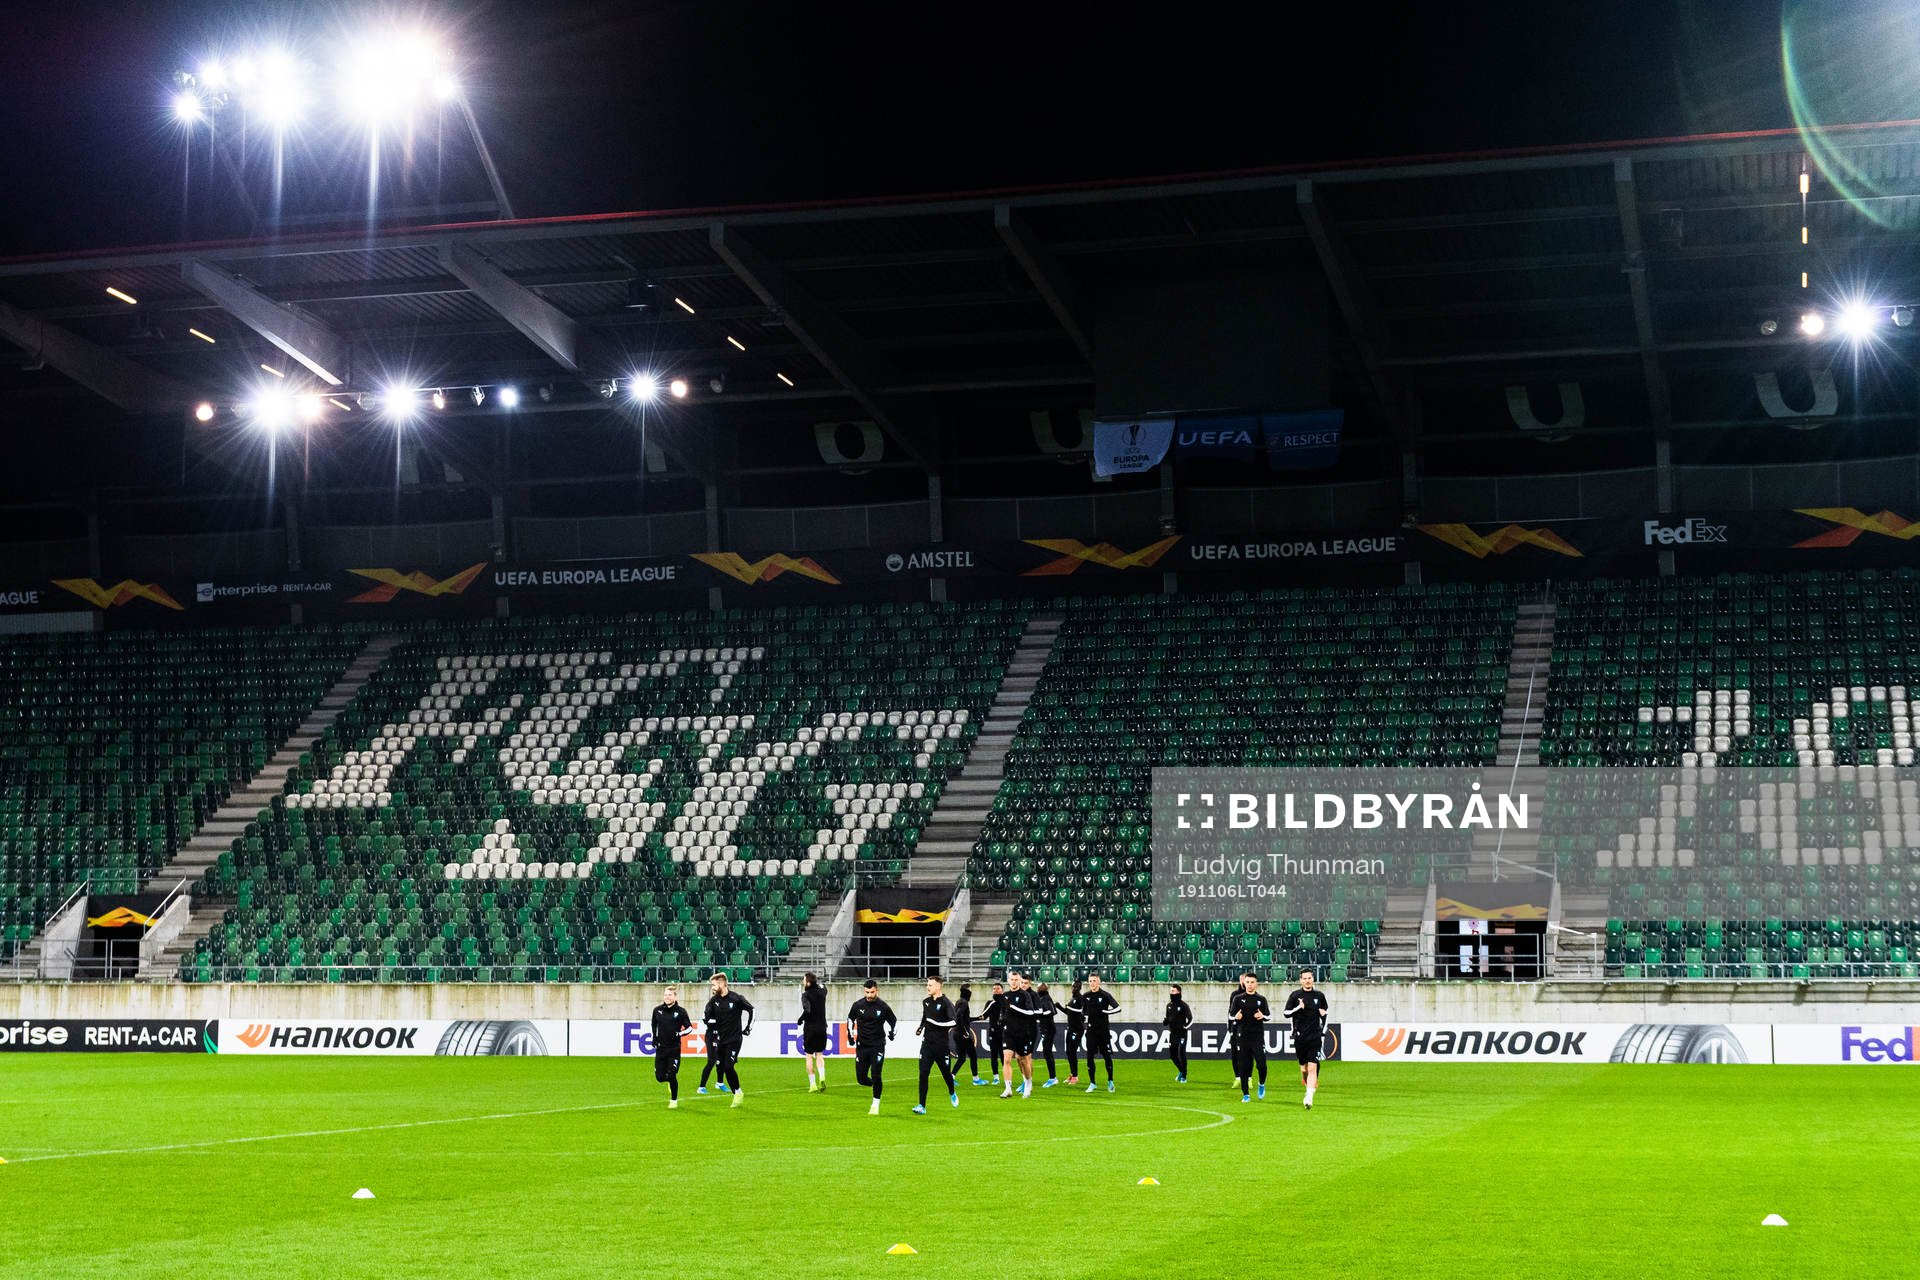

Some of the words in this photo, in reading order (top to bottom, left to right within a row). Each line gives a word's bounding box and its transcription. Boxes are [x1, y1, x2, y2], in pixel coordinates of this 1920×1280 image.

[1178, 429, 1253, 447] UEFA
[1283, 432, 1340, 448] RESPECT
[1643, 517, 1728, 545] FedEx
[1190, 545, 1240, 560] UEFA
[1245, 542, 1317, 558] EUROPA
[1322, 537, 1396, 556] LEAGUE
[907, 551, 975, 569] AMSTEL
[494, 571, 538, 586] UEFA
[542, 570, 606, 585] EUROPA
[610, 565, 676, 583] LEAGUE
[282, 582, 333, 593] RENT-A-CAR
[84, 1026, 197, 1046] RENT-A-CAR
[269, 1026, 419, 1049] HANKOOK
[1404, 1030, 1588, 1056] HANKOOK
